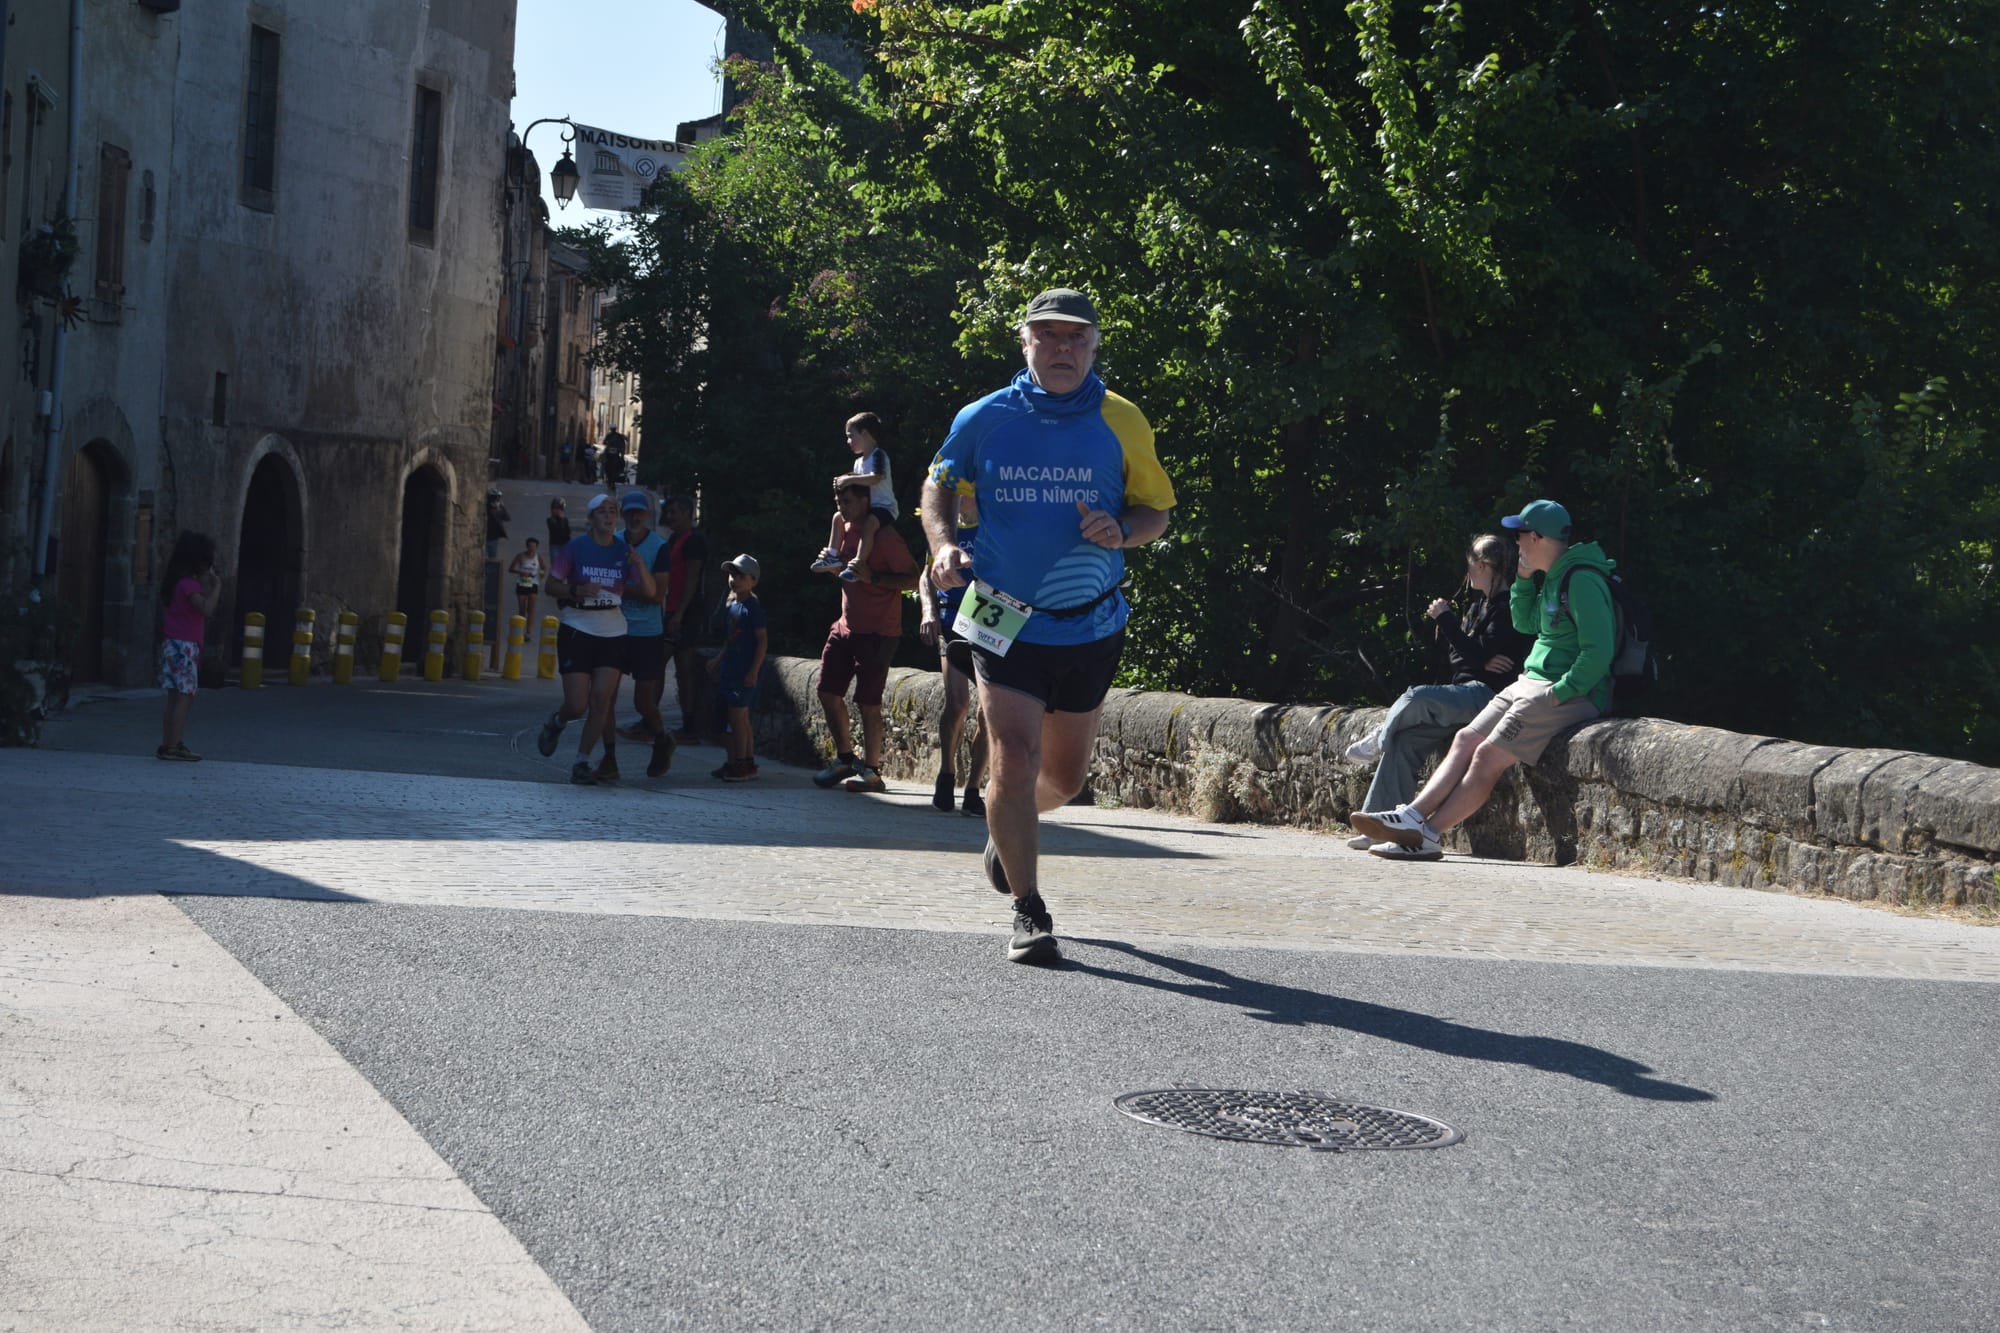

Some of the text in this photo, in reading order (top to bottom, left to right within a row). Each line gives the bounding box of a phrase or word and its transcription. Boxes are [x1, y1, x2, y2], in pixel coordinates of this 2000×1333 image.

[581, 129, 656, 151] MAISON
[1000, 466, 1092, 482] MACADAM
[995, 486, 1099, 503] CLUB NÎMOIS
[971, 596, 1004, 627] 73
